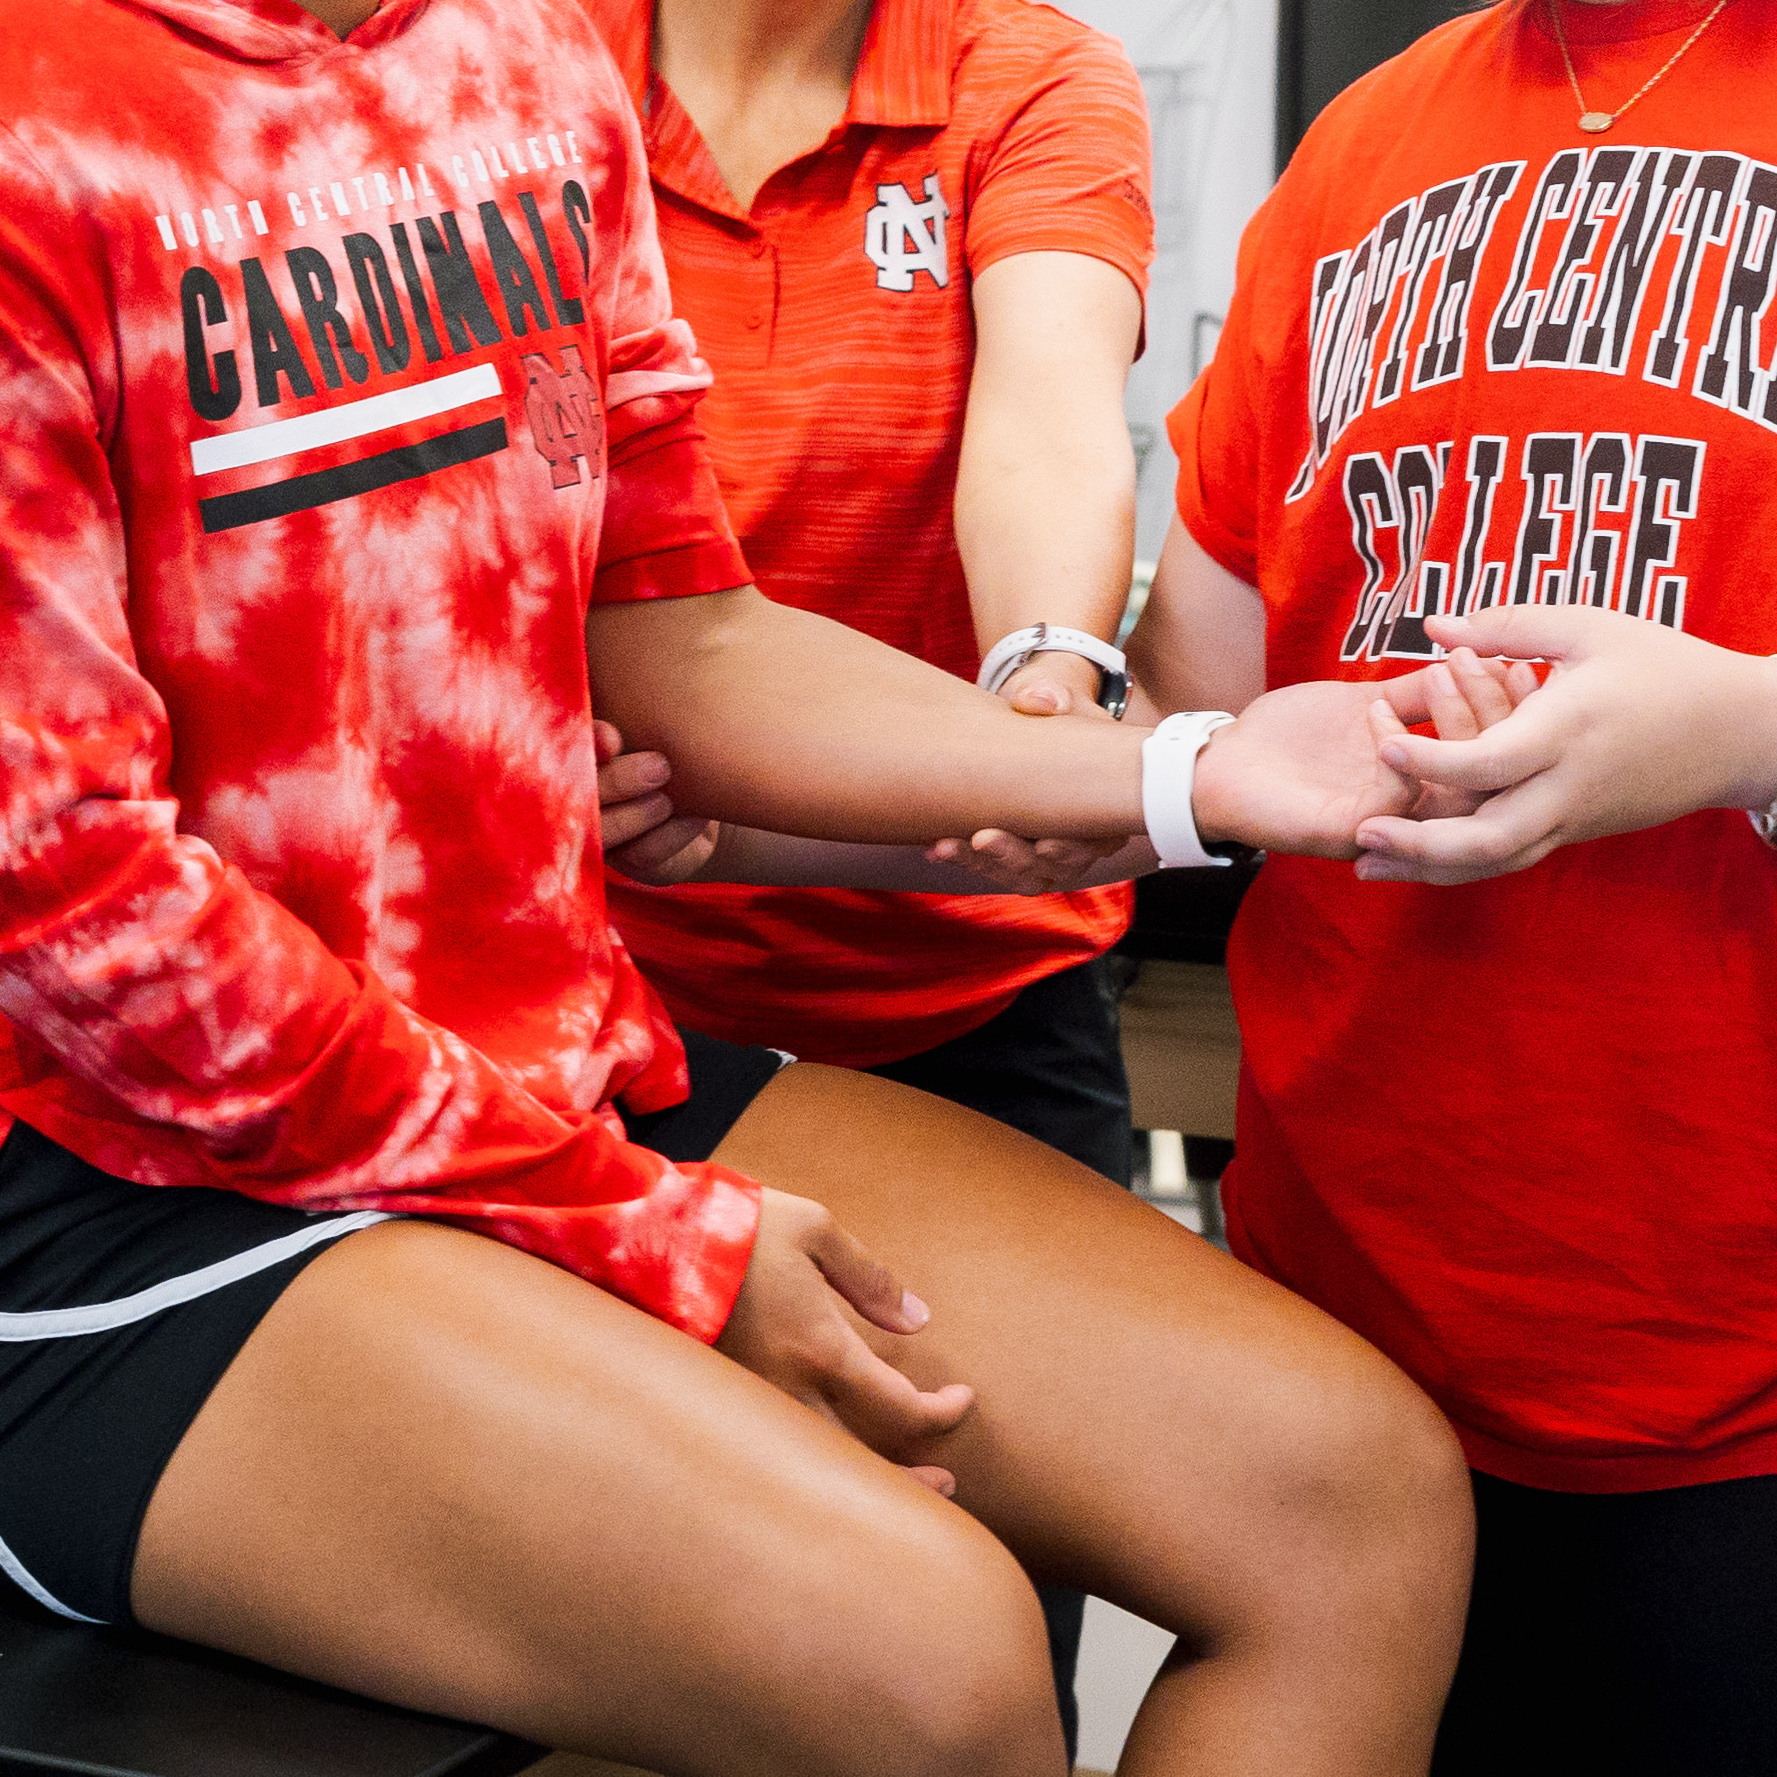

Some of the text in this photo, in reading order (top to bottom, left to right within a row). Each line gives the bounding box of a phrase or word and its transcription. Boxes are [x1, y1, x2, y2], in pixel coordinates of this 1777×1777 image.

[155, 130, 583, 251] NORTH CENTRAL COLLEGE
[179, 179, 592, 421] CARDINALS
